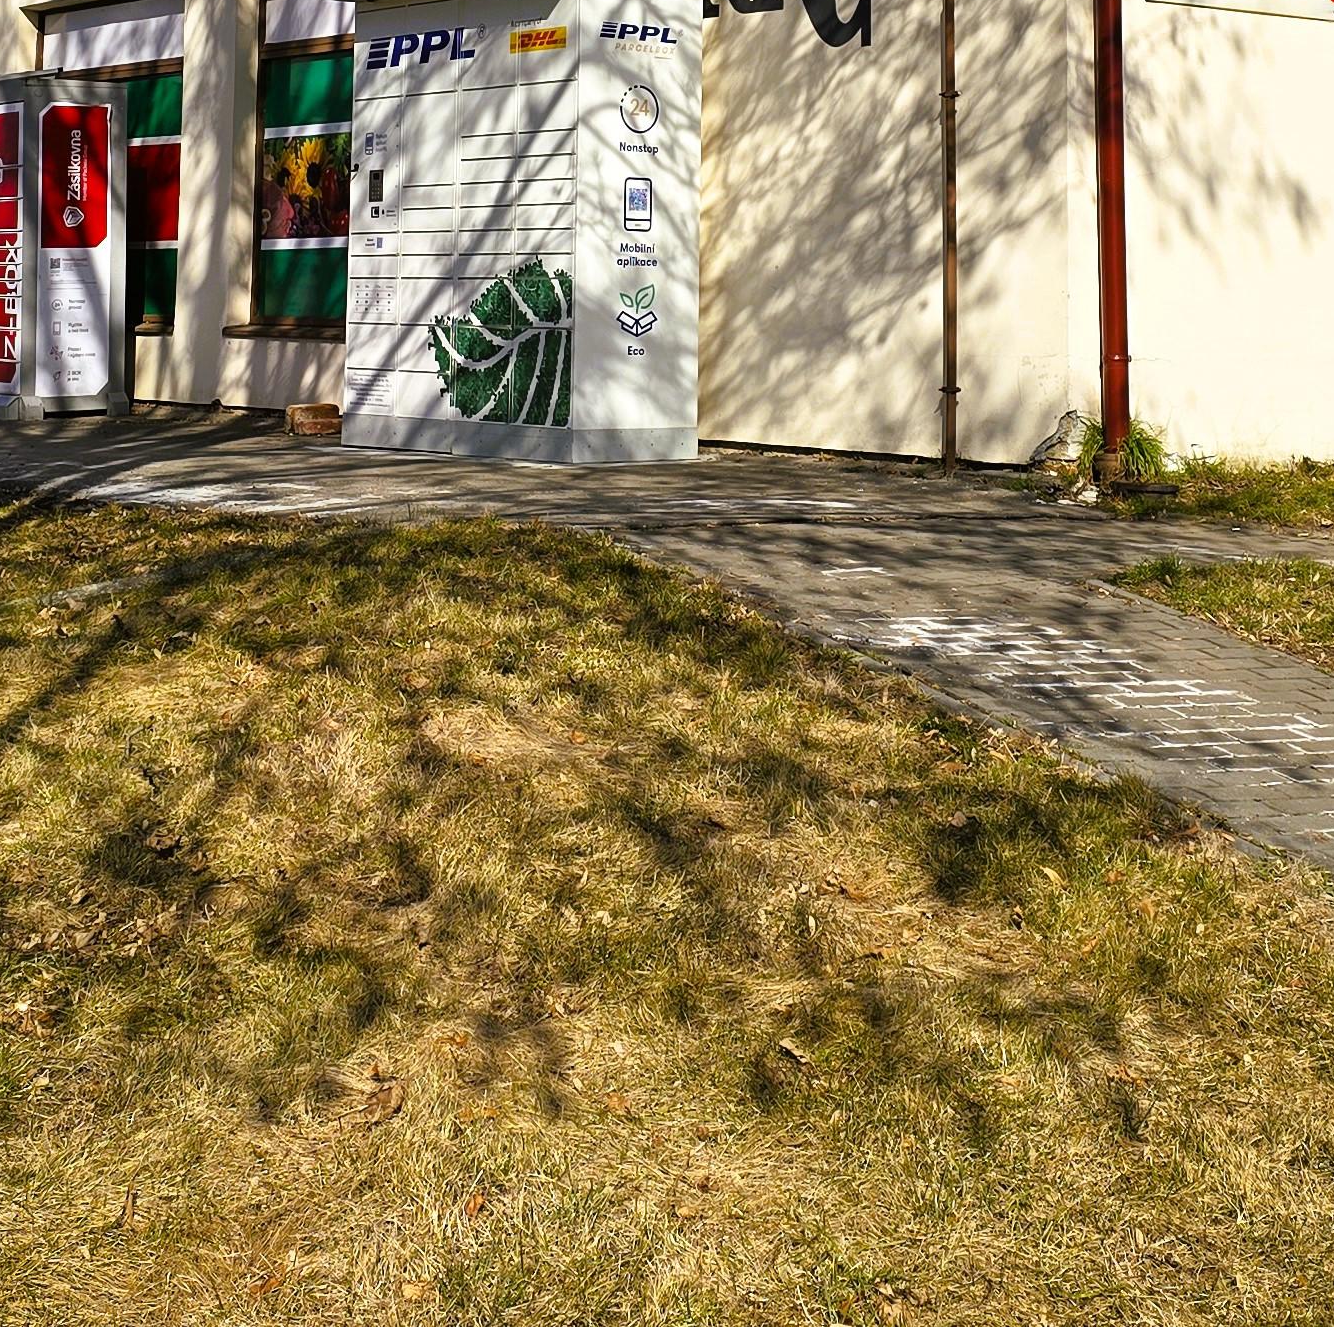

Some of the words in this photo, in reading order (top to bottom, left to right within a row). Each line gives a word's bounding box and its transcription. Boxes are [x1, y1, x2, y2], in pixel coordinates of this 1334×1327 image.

[518, 30, 557, 49] DHL
[618, 23, 678, 44] PPL
[389, 27, 476, 68] PPL
[614, 42, 676, 54] PARCELBOX
[629, 98, 650, 117] 24
[619, 141, 659, 156] Nonstop
[67, 129, 82, 202] Zásilkovna
[619, 242, 656, 255] Mobilní
[616, 256, 659, 268] aplikace
[627, 345, 646, 357] Eco
